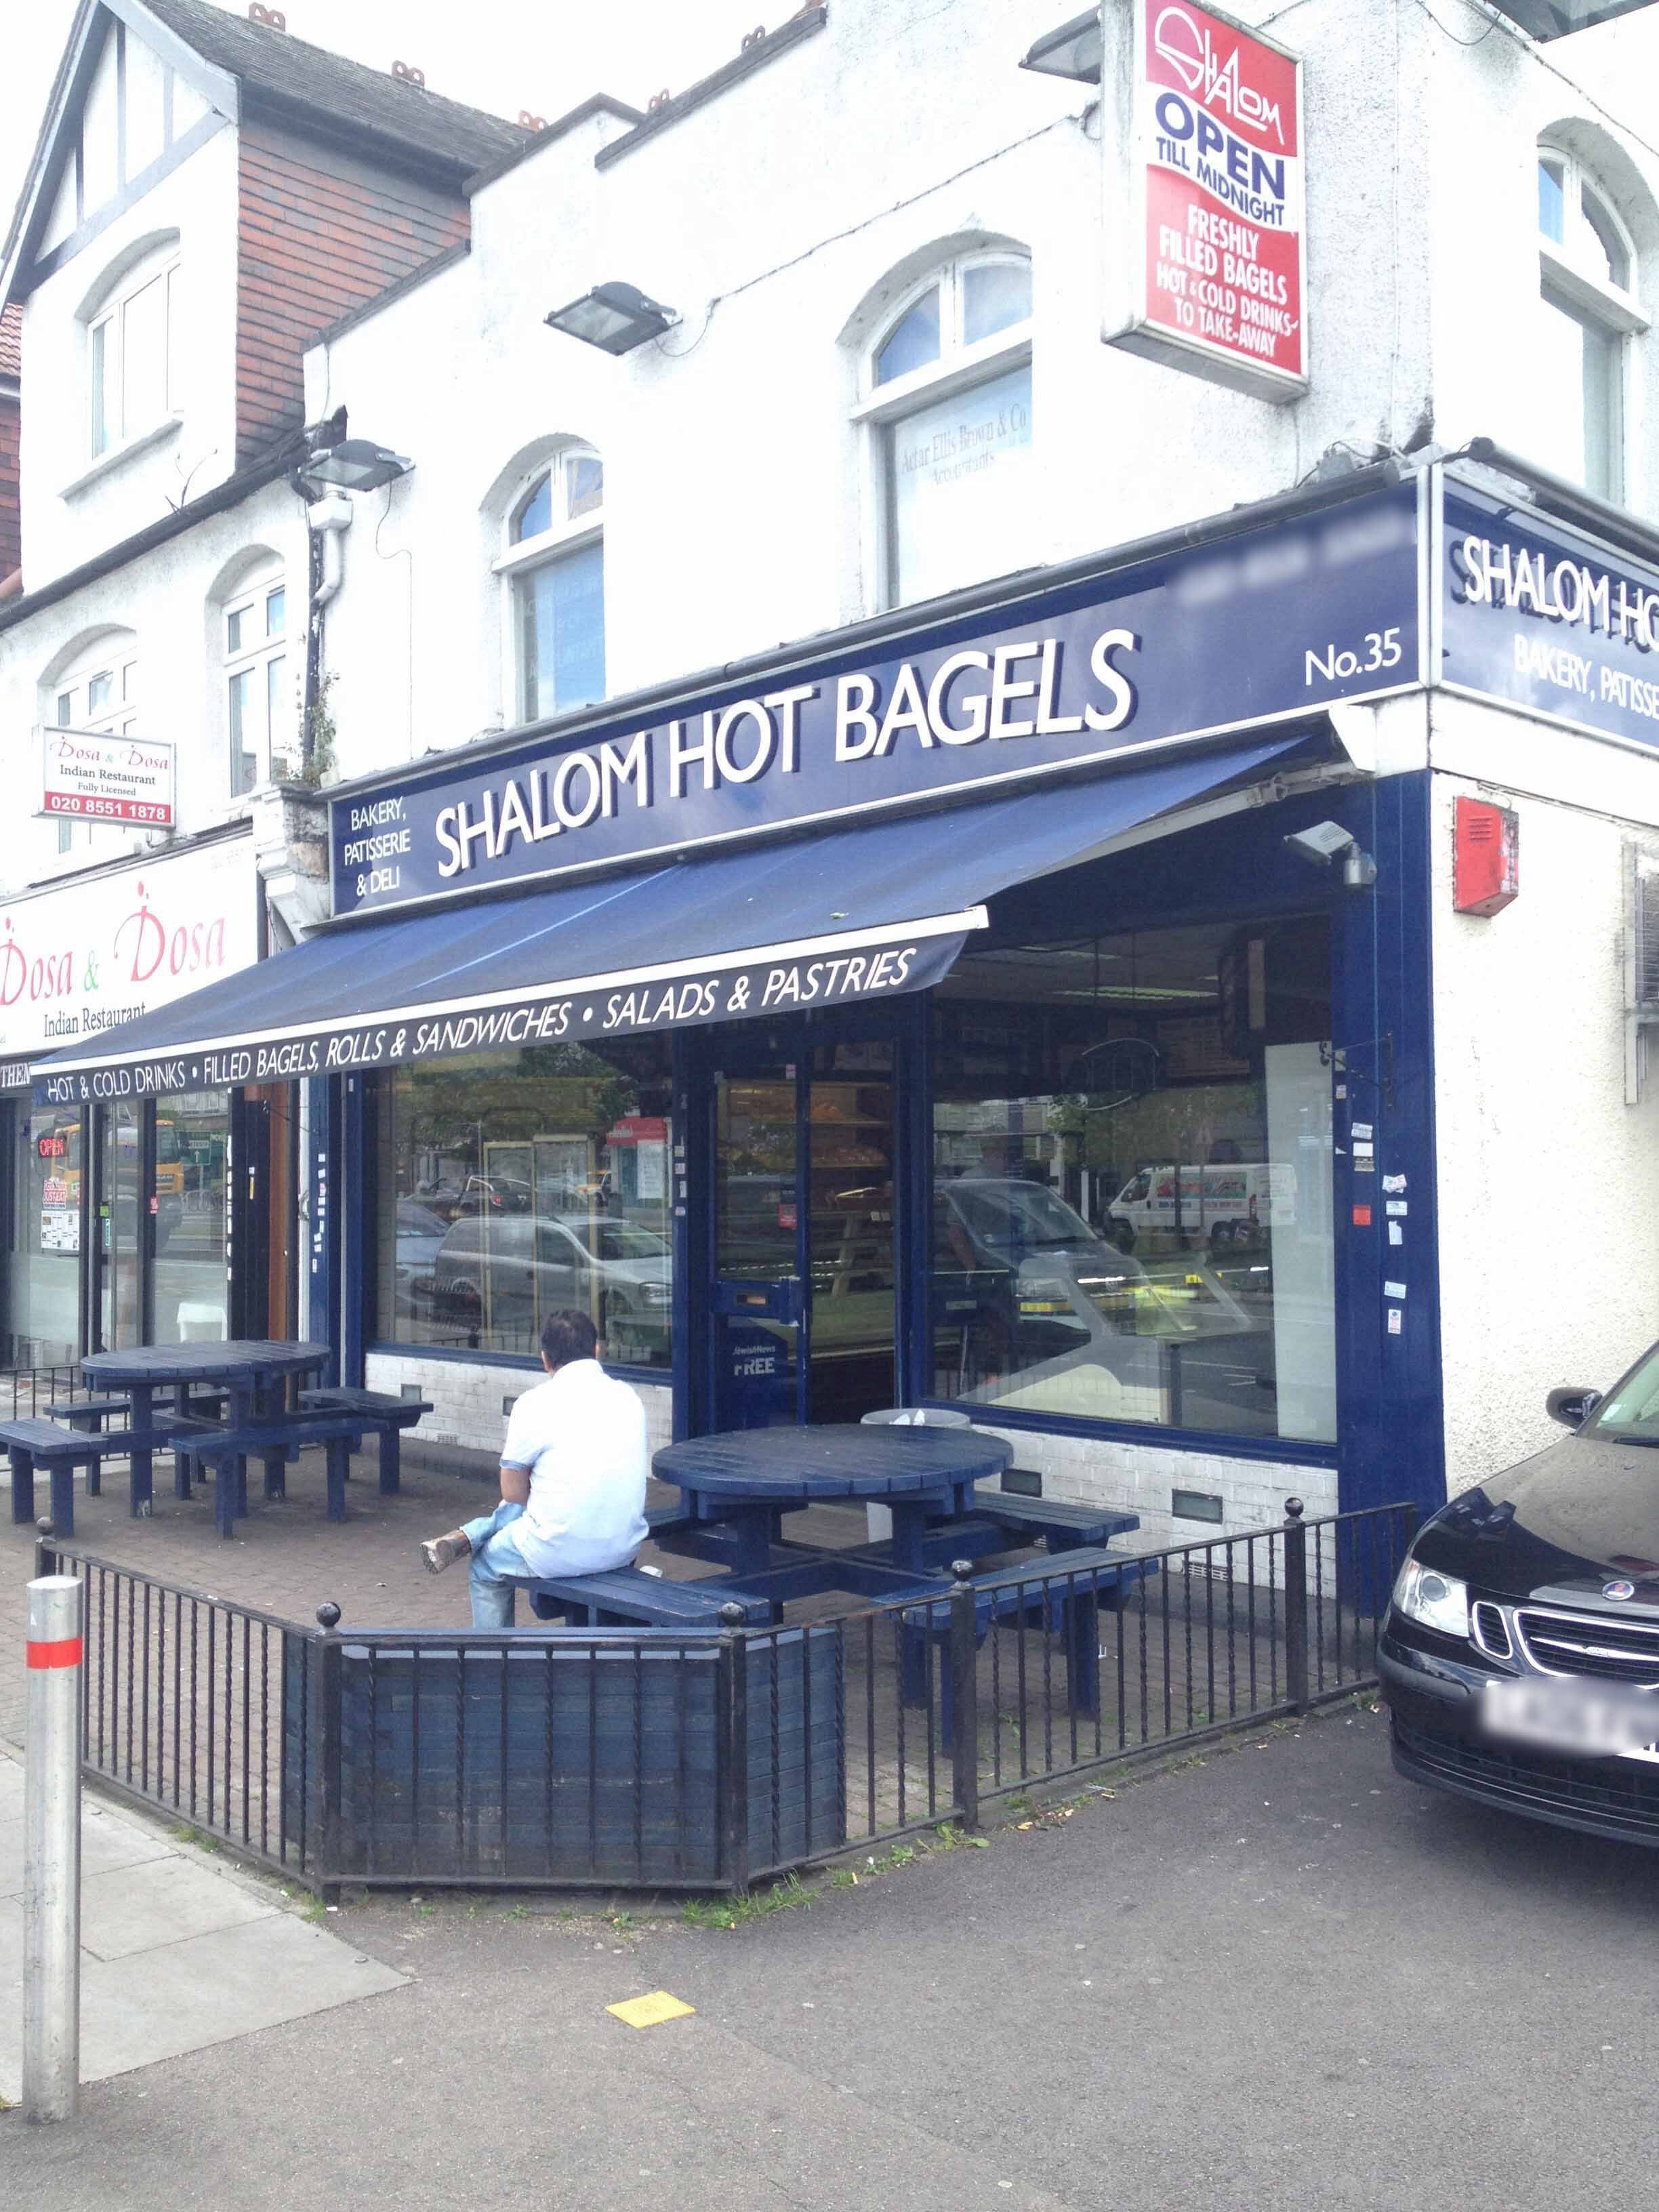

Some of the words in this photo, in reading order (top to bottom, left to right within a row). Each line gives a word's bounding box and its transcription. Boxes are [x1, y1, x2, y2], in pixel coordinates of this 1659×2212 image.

[1155, 5, 1285, 145] SHALOM
[1155, 91, 1285, 201] OPEN
[1156, 136, 1190, 171] TILL
[1197, 158, 1285, 226] MIDNIGHT
[1187, 204, 1259, 261] FRESHLY
[1160, 226, 1218, 278] FILLED
[1223, 251, 1287, 306] BAGELS
[1156, 262, 1187, 296] HOT
[1198, 280, 1236, 315] COLD
[1240, 295, 1290, 337] DRINKS
[1174, 297, 1193, 327] TO
[1198, 307, 1276, 358] TAKE-AWAY
[1463, 535, 1609, 631] SHALOM
[1305, 627, 1401, 686] No.35
[1514, 634, 1595, 703] BAKERY,
[49, 735, 100, 760] Dosa
[106, 754, 114, 764] &
[120, 745, 168, 769] Dosa
[60, 764, 95, 778] Indian
[99, 769, 156, 785] Restaurant
[435, 731, 647, 878] SHALOM
[670, 685, 813, 798] HOT
[835, 629, 1134, 762] BAGELS
[52, 796, 80, 811] 020
[85, 800, 122, 815] 8551
[129, 804, 165, 819] 1878
[78, 782, 98, 793] Fully
[101, 785, 136, 796] Licensed
[350, 796, 407, 832] BAKERY,
[344, 829, 411, 866] PATISSERIE
[356, 874, 366, 897] &
[370, 866, 401, 895] DELI
[0, 918, 73, 1006] Dosa
[83, 950, 99, 991] &
[114, 881, 226, 981] Dosa
[44, 1014, 78, 1038] Indian
[83, 1002, 145, 1032] Restaurant
[47, 1076, 74, 1103] HOT
[81, 1076, 89, 1099] &
[93, 1070, 130, 1098] COLD
[136, 1061, 185, 1093] DRINKS
[203, 1051, 251, 1084] FILLED
[256, 1040, 319, 1075] BAGELS,
[325, 1030, 386, 1067] ROLLS
[390, 1028, 406, 1057] &
[413, 1001, 572, 1055] SANDWICHES
[602, 979, 720, 1029] SALADS
[726, 975, 750, 1012] &
[760, 947, 917, 1006] PASTRIES
[39, 1139, 64, 1156] OPEN
